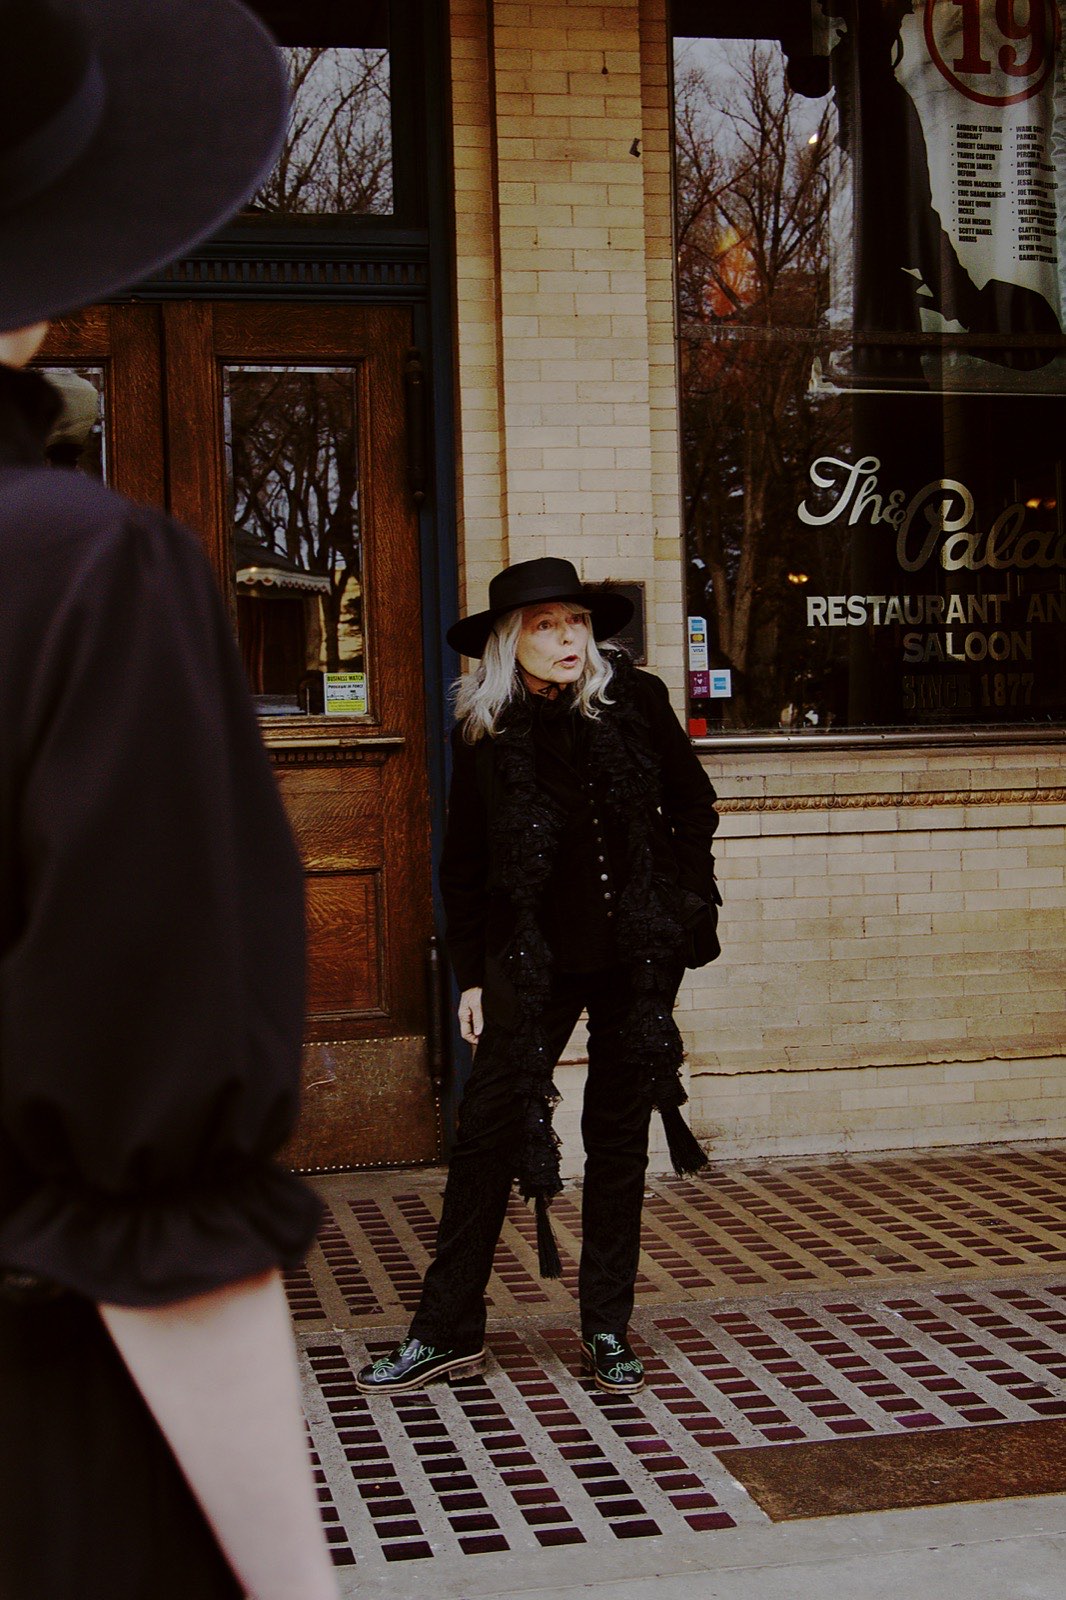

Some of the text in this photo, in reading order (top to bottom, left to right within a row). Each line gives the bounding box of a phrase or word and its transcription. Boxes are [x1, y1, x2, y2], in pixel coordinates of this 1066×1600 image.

[953, 0, 1046, 77] 19
[806, 594, 1009, 627] RESTAURANT
[902, 631, 1033, 663] SALOON
[980, 672, 1035, 707] 1877
